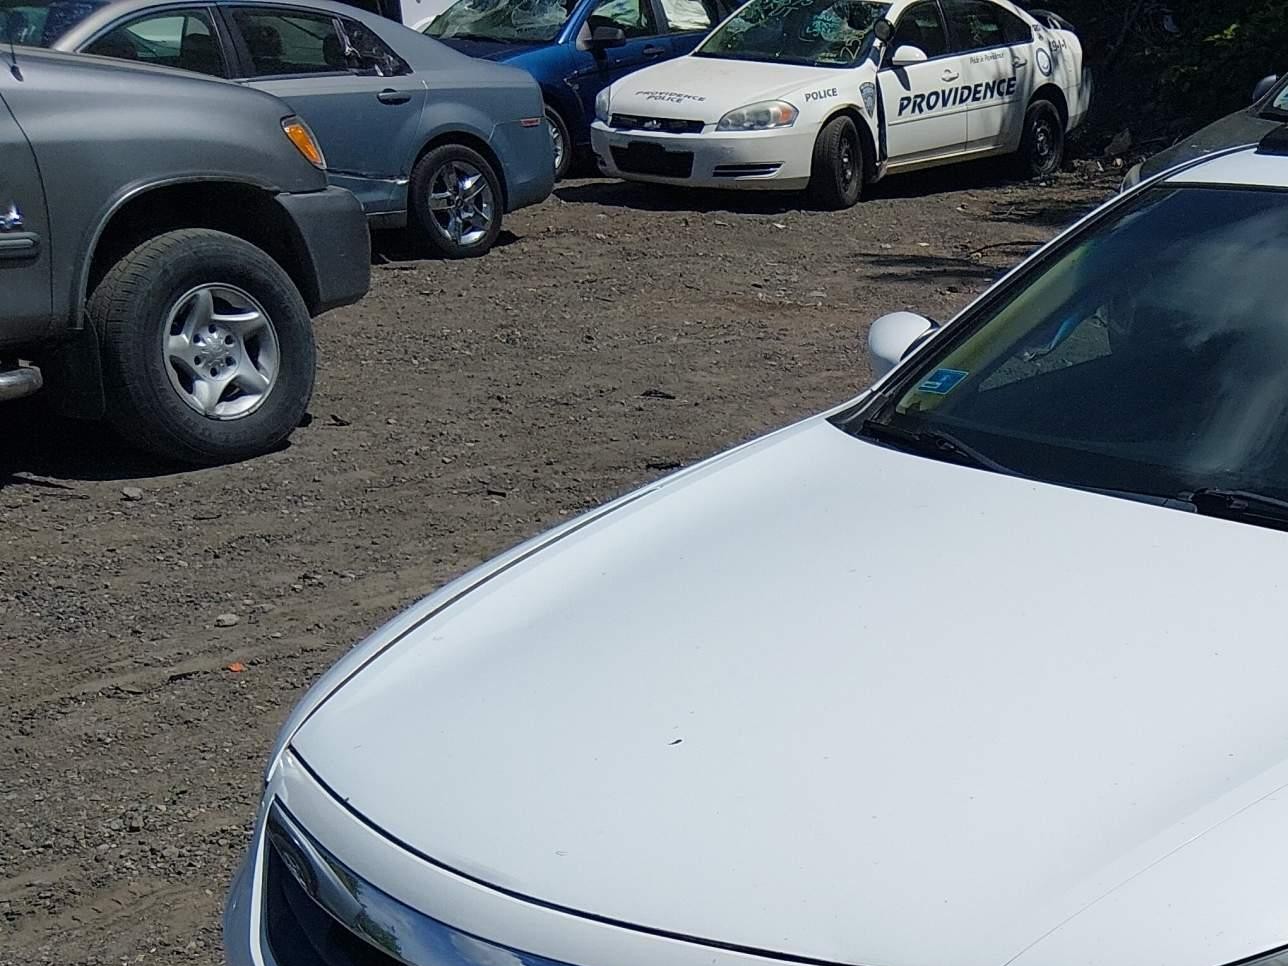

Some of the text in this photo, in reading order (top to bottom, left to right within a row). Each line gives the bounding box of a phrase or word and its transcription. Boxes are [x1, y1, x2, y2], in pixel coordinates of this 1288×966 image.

[635, 91, 706, 102] PROVIDENCE
[646, 95, 682, 104] POLICE
[804, 88, 838, 102] POLICE
[898, 76, 1017, 116] PROVIDENCE
